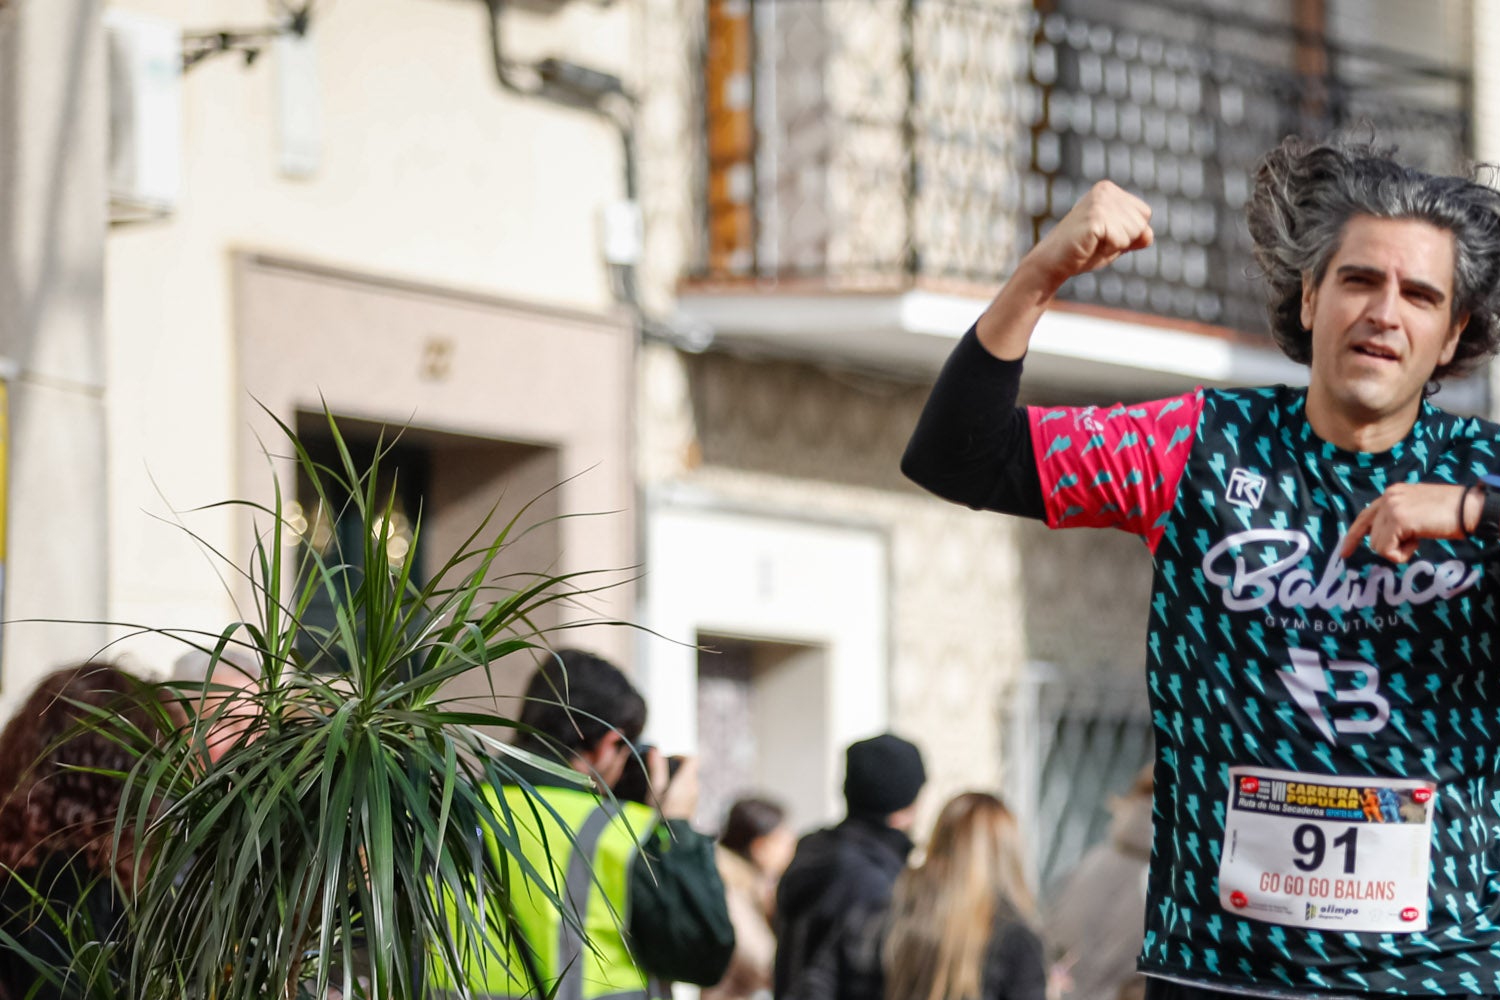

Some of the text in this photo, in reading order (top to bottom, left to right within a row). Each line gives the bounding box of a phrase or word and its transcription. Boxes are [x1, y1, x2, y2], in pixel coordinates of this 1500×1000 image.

[1264, 615, 1305, 630] GYM
[1286, 783, 1359, 801] CARRERA
[1238, 797, 1256, 808] Ruta
[1257, 800, 1267, 810] de
[1268, 802, 1281, 812] los
[1286, 793, 1359, 810] POPULAR
[1292, 823, 1358, 874] 91
[1259, 872, 1396, 901] GO GO GO BALANS
[1320, 904, 1359, 916] olimpo
